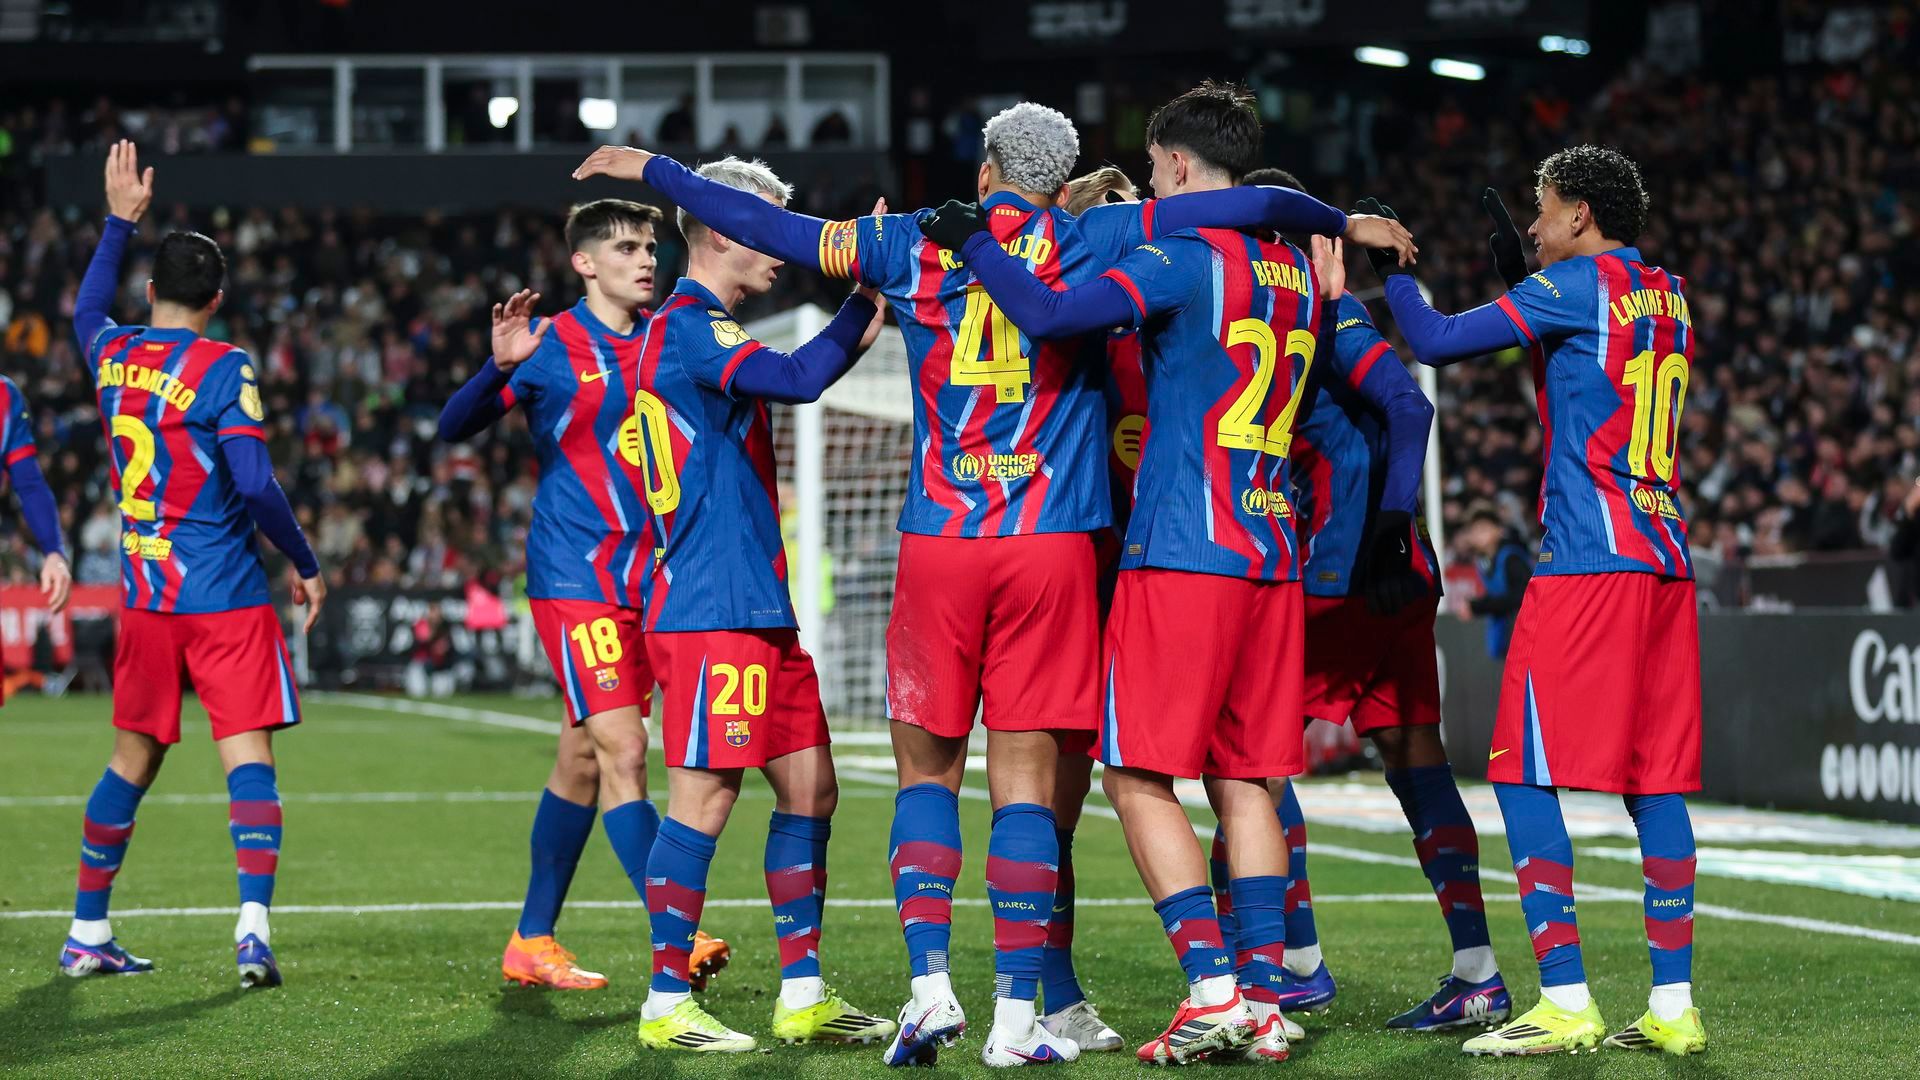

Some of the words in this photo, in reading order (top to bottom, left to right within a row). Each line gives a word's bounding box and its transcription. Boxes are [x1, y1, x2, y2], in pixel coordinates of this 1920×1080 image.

[938, 249, 964, 272] R.
[1251, 260, 1309, 297] BERNAL
[1609, 289, 1664, 327] LAMINE
[950, 285, 1031, 404] 4
[126, 364, 197, 412] CANCELO
[1216, 317, 1316, 459] 22
[1621, 350, 1689, 482] 10
[111, 414, 156, 521] 2
[987, 454, 1037, 466] UNHCR
[987, 463, 1036, 477] ACNUR
[570, 617, 623, 668] 18
[711, 663, 767, 716] 20
[998, 901, 1036, 911] BARÇA
[1652, 898, 1687, 908] BARÇA
